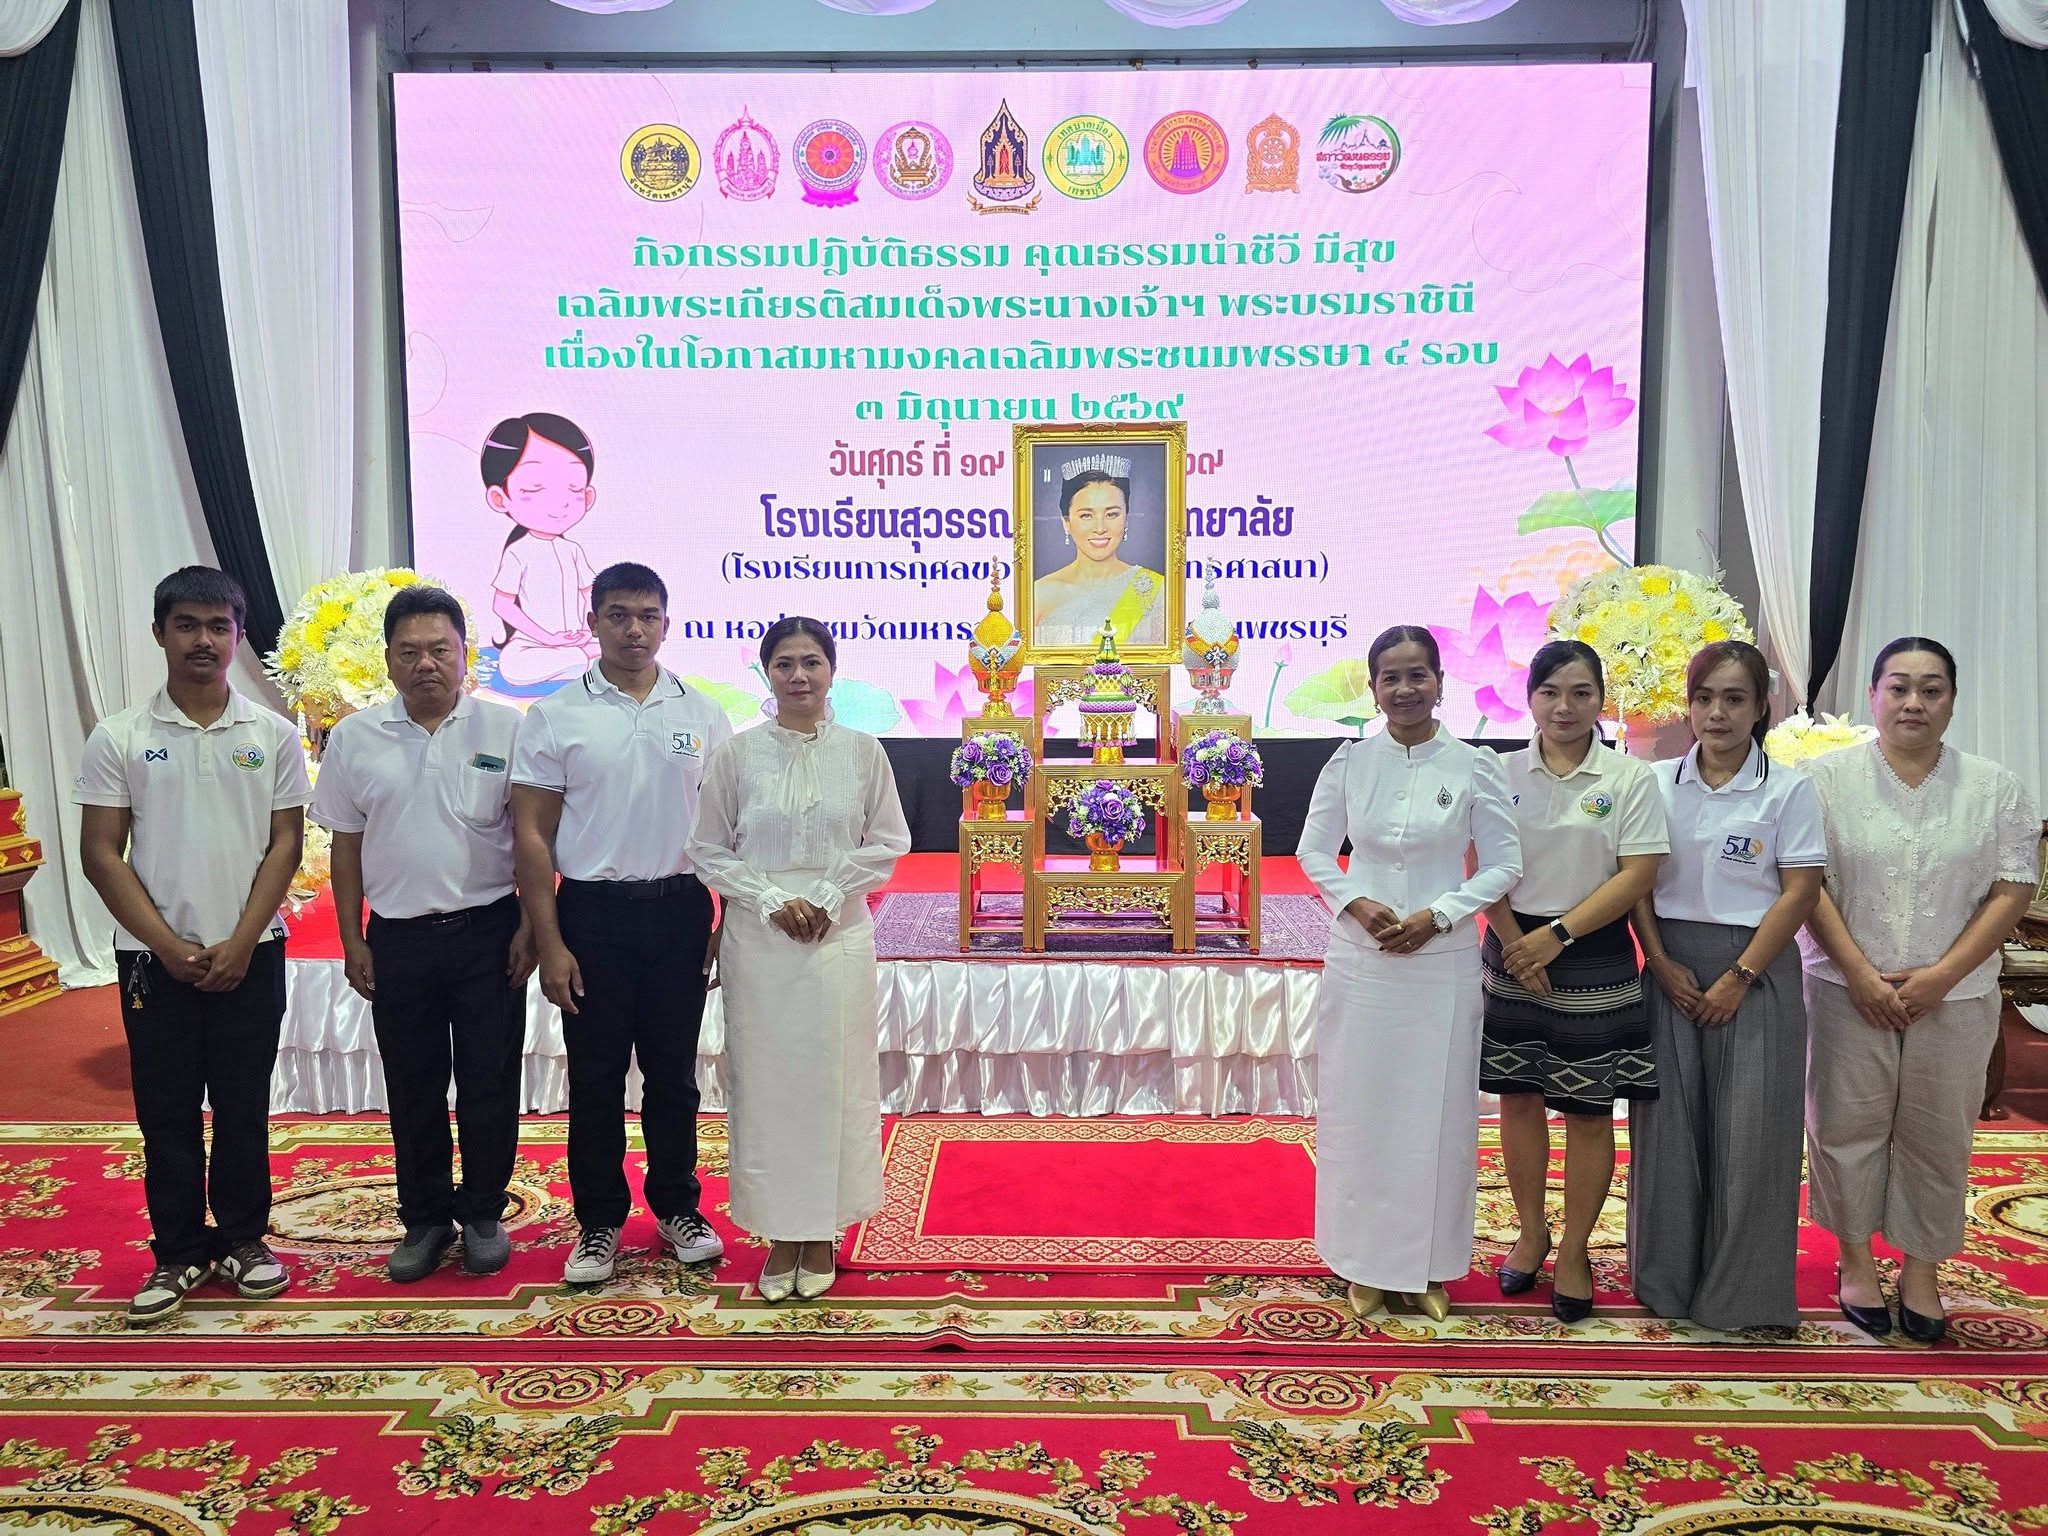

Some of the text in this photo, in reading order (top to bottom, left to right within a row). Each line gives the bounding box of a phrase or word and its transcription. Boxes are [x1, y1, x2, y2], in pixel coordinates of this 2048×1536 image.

[634, 231, 1396, 276] กิจกรรมปฏิบัติธรรม คุณธรรมนำชีวี มีสุข
[557, 281, 1474, 319] เฉลิมพระเกียรติสมเด็จพระนางเจ้าฯ พระบรมราชินี
[544, 328, 1499, 370] เนื่องในโอกาสมหามงคลเฉลิมพระชนมพรรษา ๔ รอบ
[855, 389, 1185, 430] ๓ มิถุนายน ๒๕๖๙
[830, 440, 925, 488] วันศุกร์
[933, 431, 950, 476] ที่
[960, 450, 1004, 477] ๑๙
[721, 551, 1015, 588] (โรงเรียนการกุศลขอ
[685, 620, 714, 639] ณ
